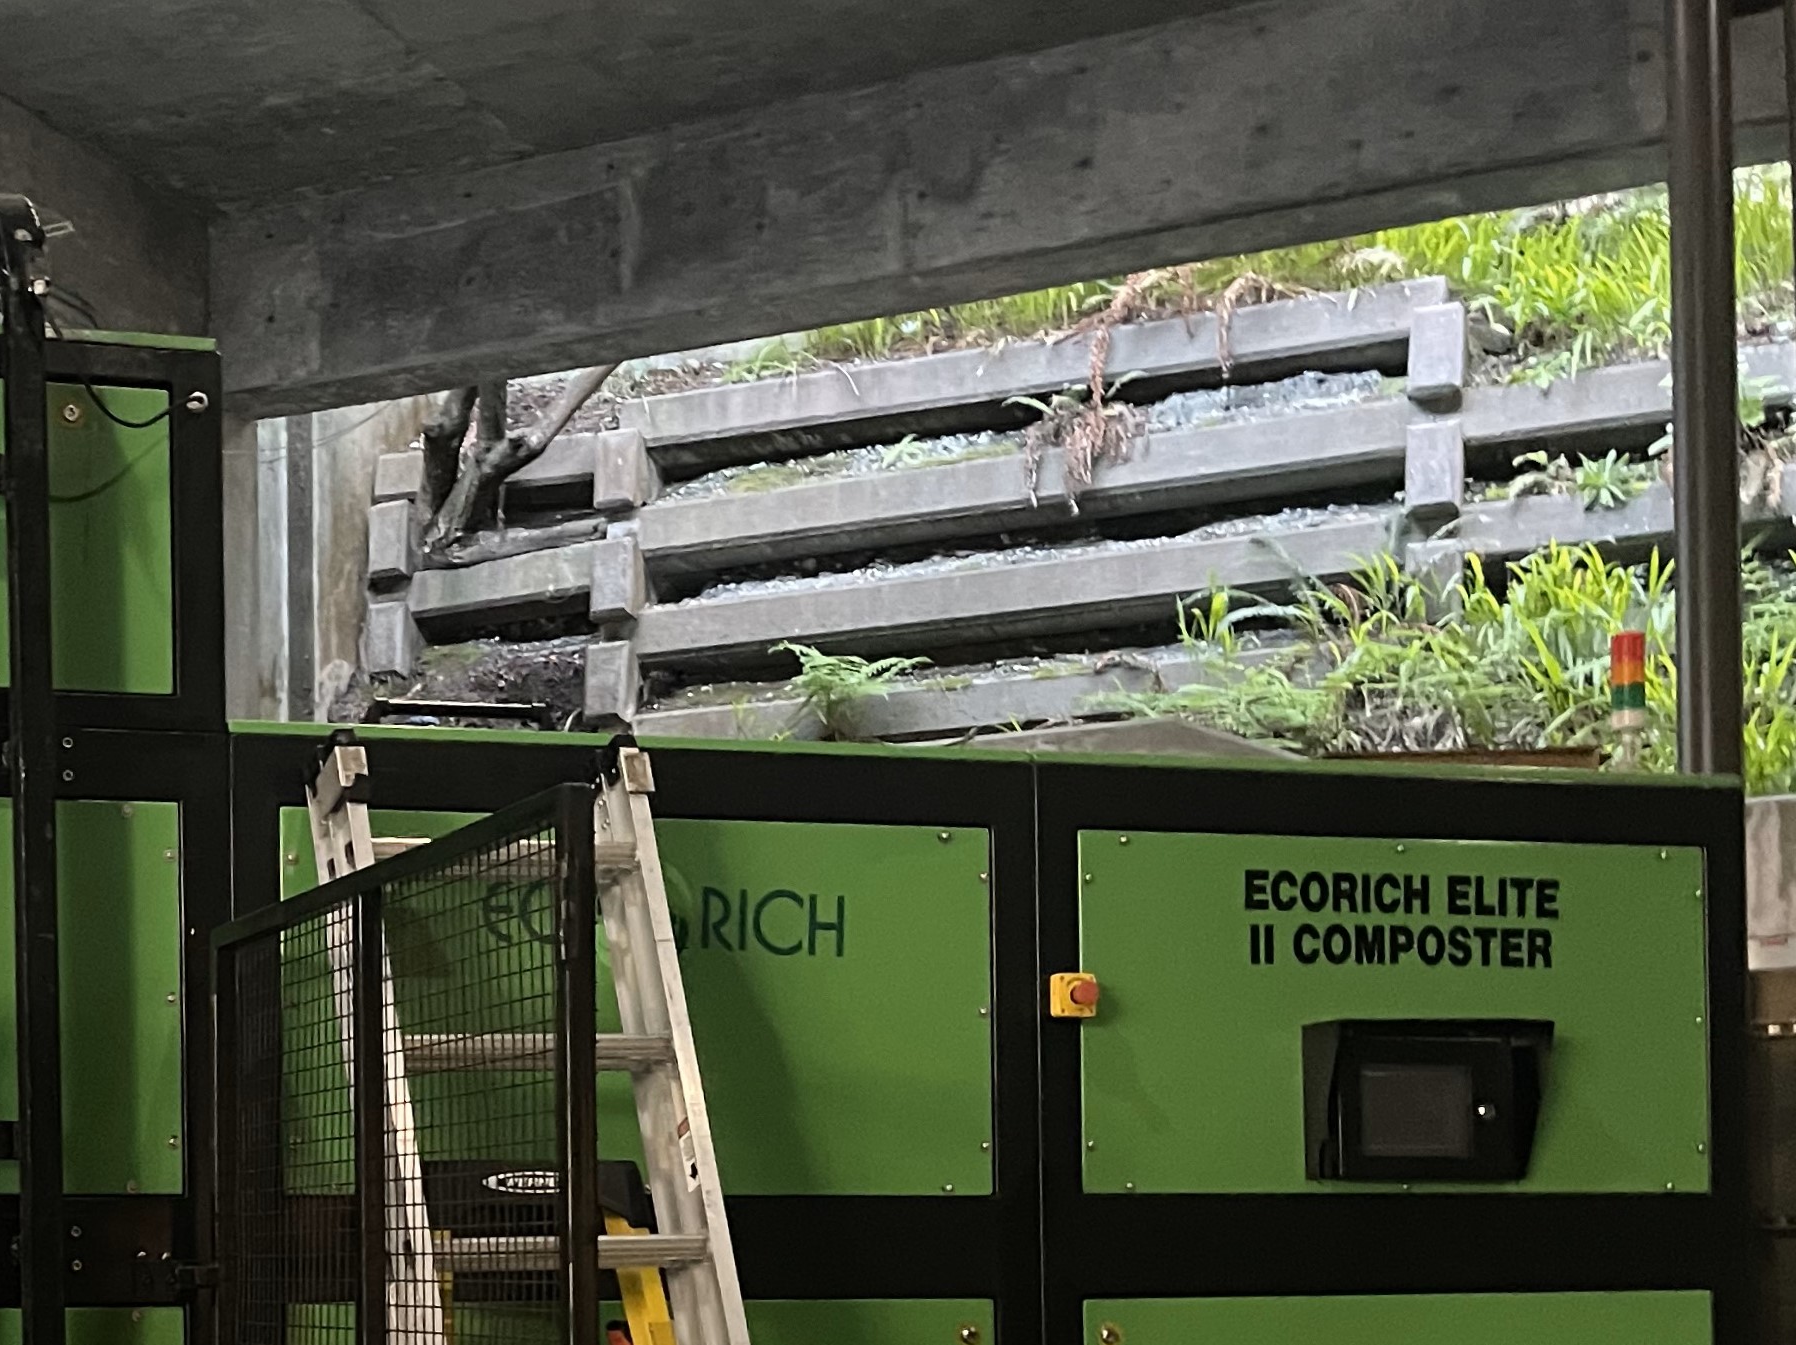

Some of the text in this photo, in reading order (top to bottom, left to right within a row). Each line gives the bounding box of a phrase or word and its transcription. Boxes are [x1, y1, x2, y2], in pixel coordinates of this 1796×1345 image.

[1244, 869, 1560, 920] ECORICH ELITE
[1249, 923, 1553, 969] II COMPOSTER
